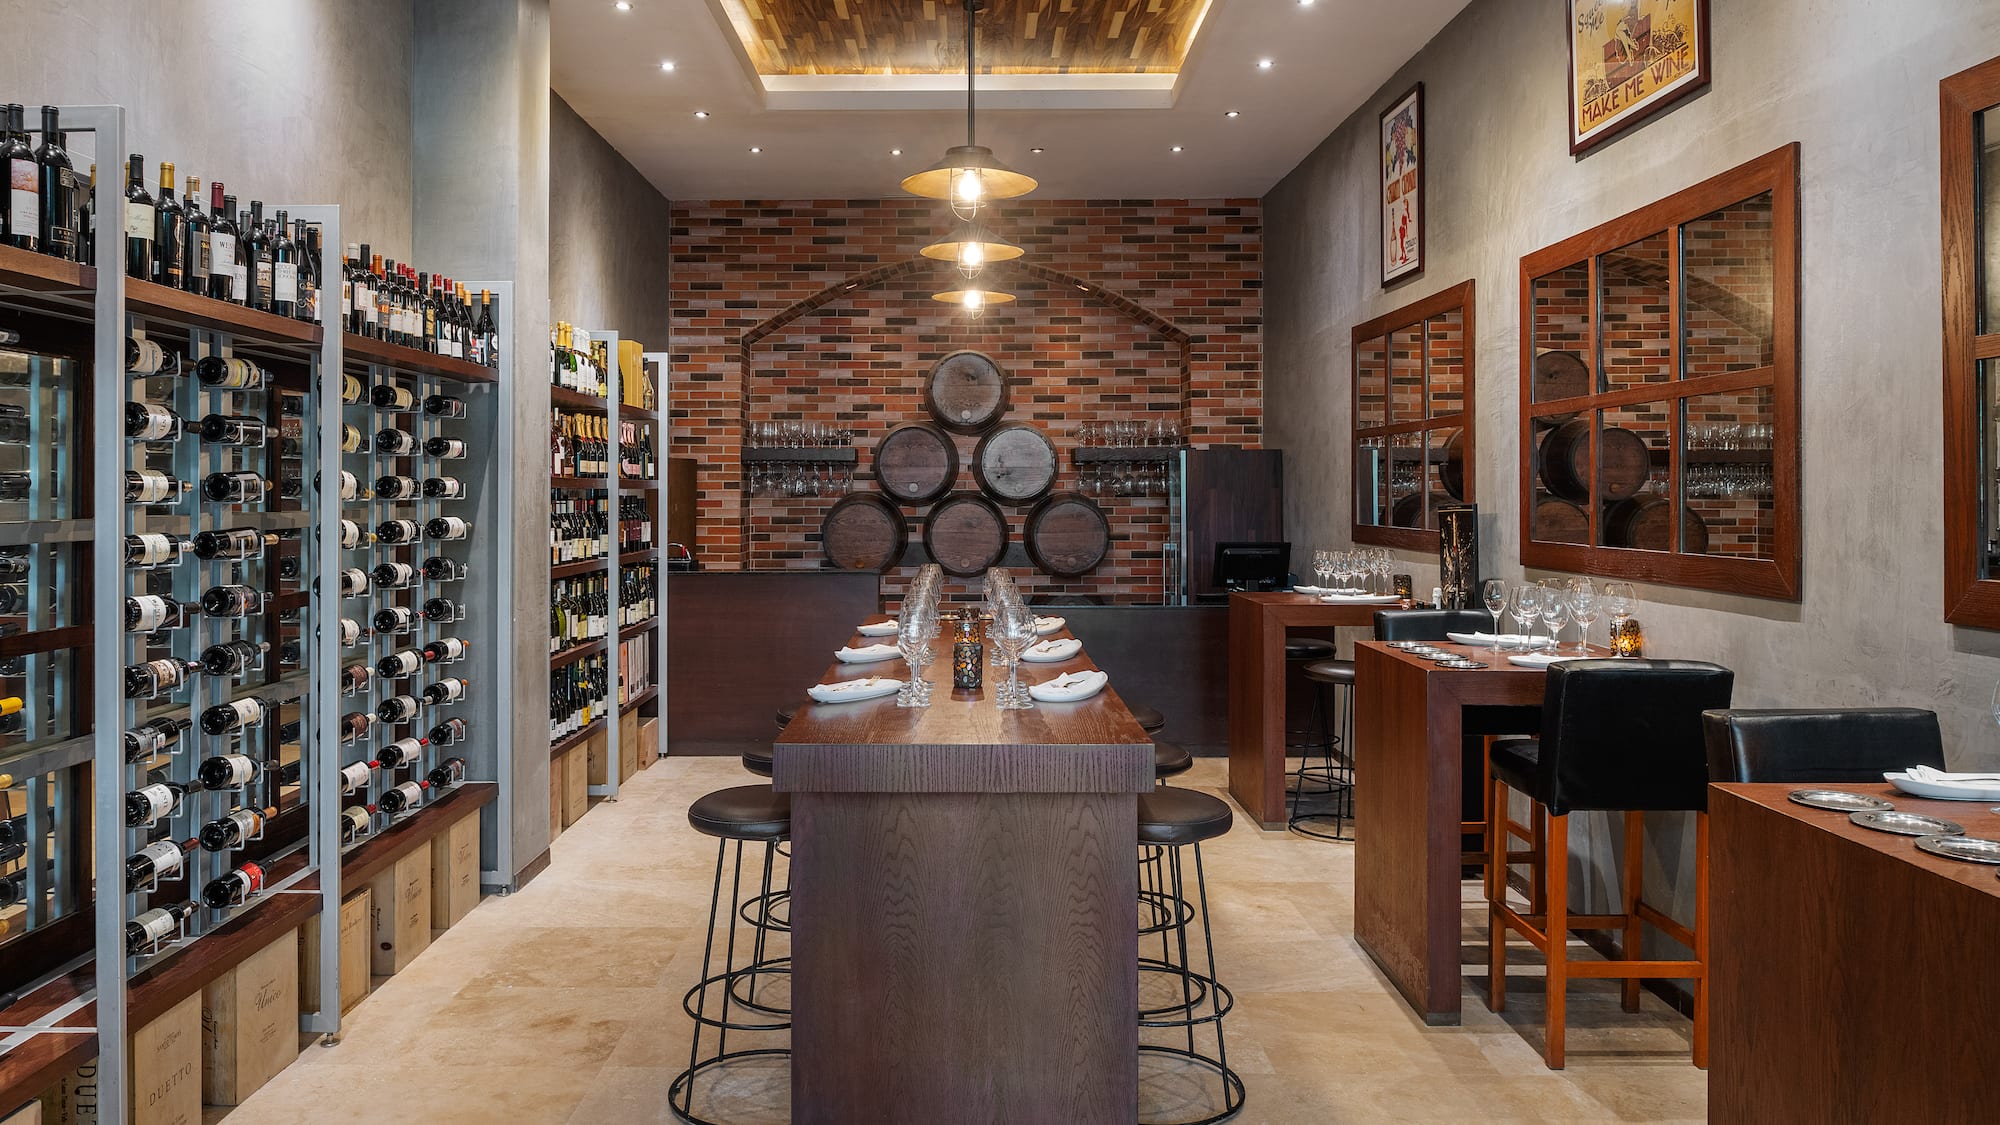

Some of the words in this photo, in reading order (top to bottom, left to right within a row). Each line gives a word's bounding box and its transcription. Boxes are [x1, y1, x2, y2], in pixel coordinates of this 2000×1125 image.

[1582, 88, 1620, 127] MAKE
[1624, 74, 1645, 102] ME
[1650, 45, 1689, 85] WINE
[75, 1064, 97, 1125] DUE
[149, 1062, 192, 1106] DUETTO
